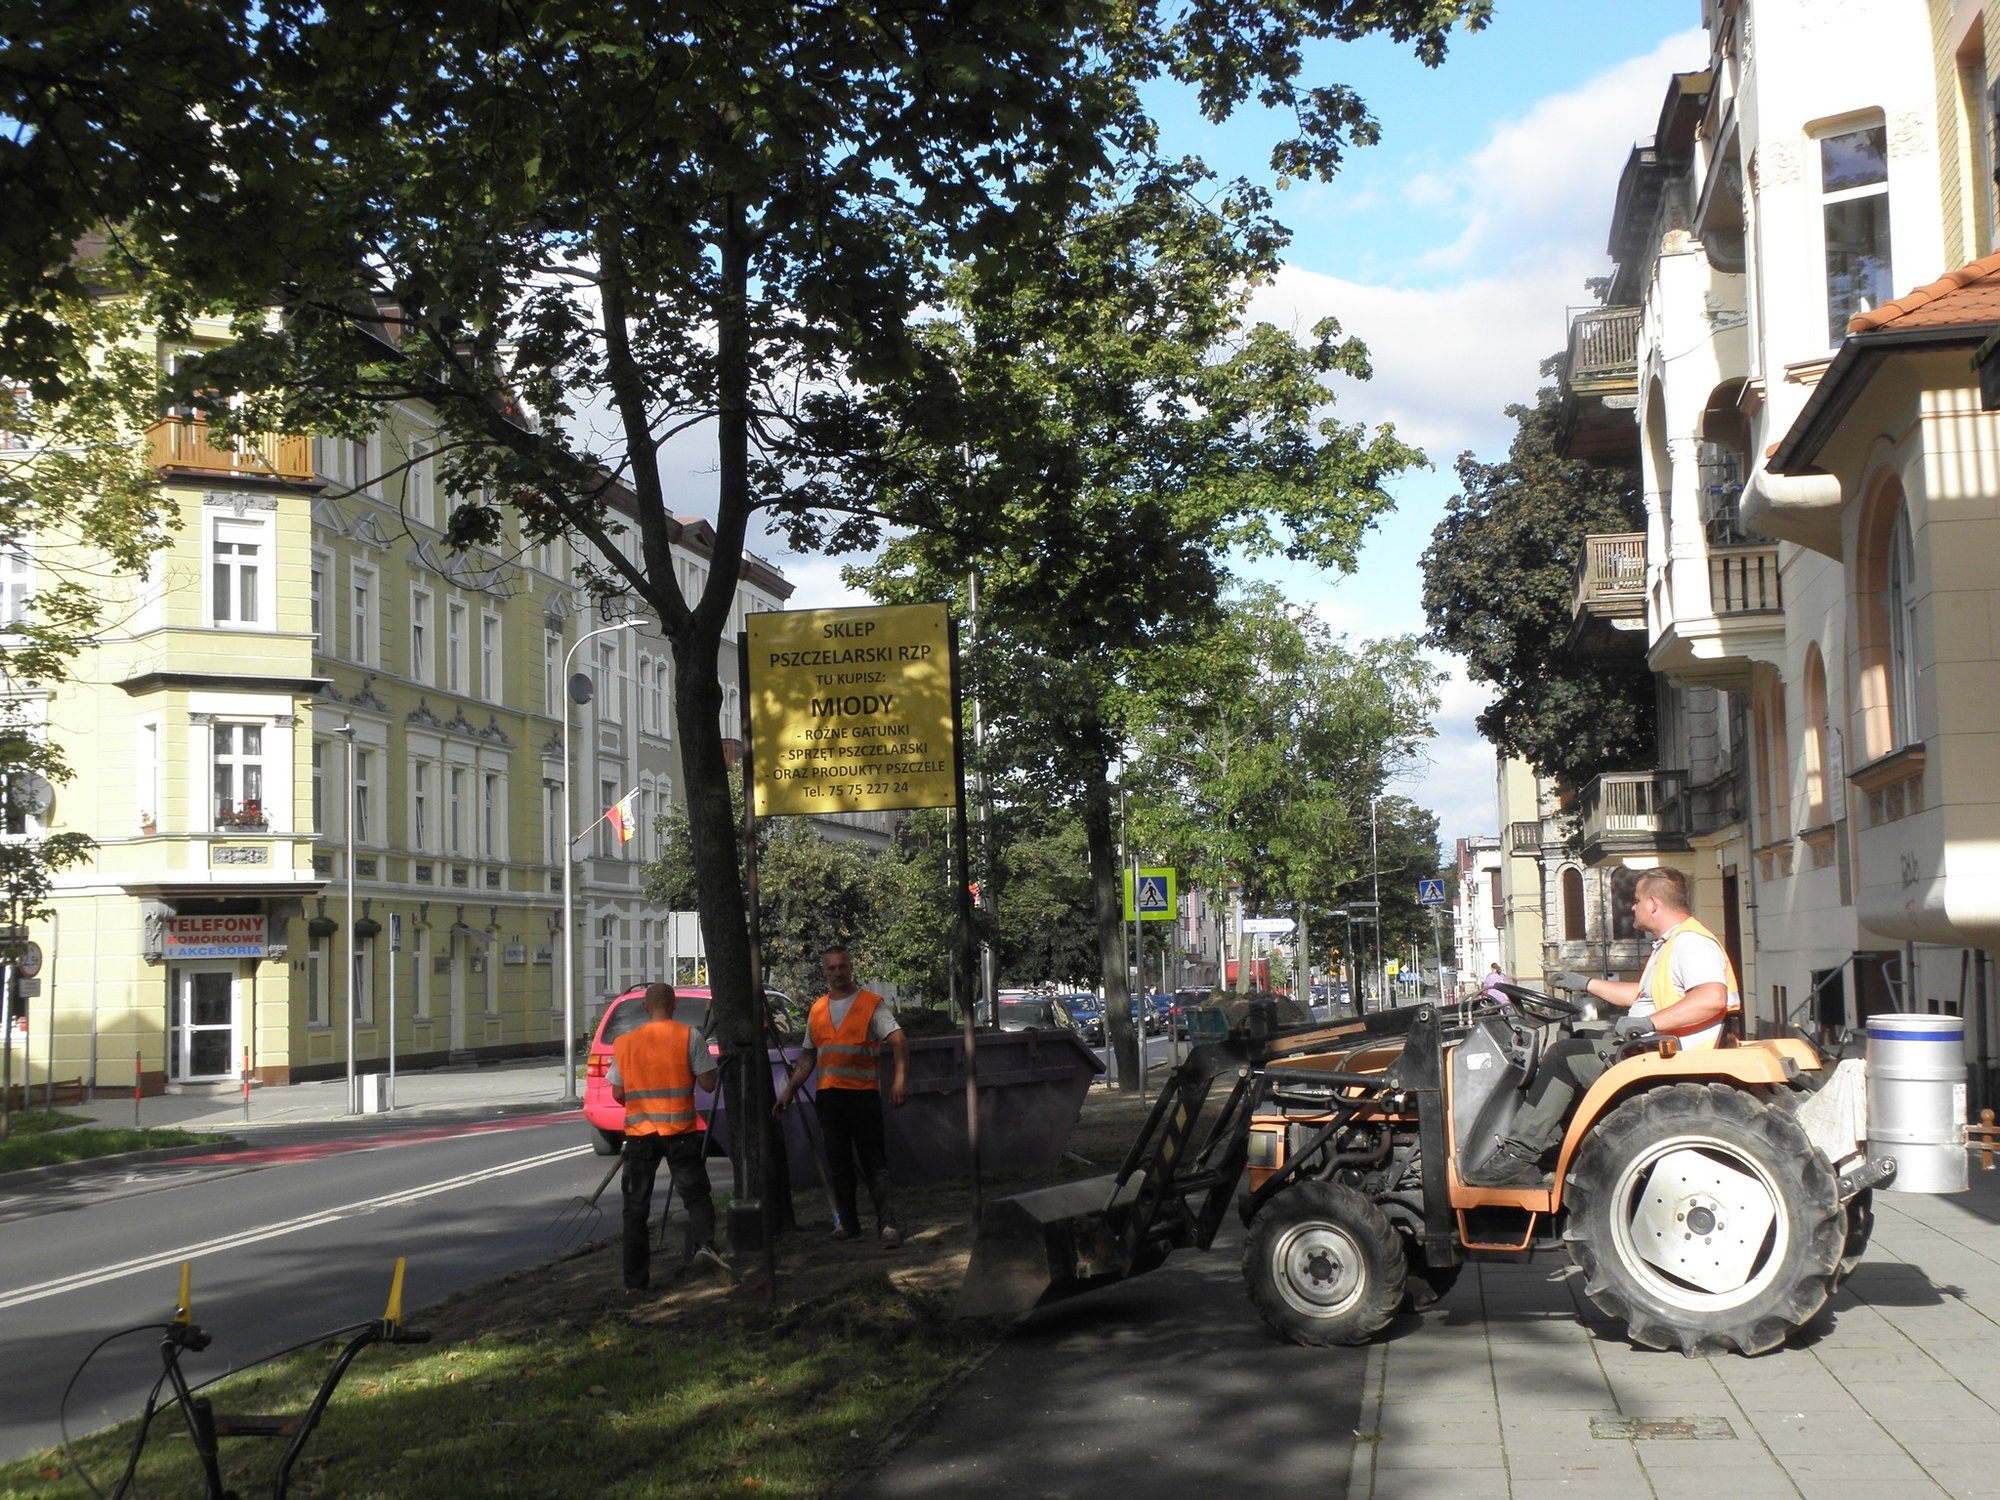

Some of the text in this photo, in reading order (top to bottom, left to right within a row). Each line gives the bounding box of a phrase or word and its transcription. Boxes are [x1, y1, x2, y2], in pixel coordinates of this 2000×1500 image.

[823, 622, 875, 639] SKLEP
[770, 645, 931, 668] PSZCZELARSKI RZP
[816, 671, 886, 686] TU KUPISZ:
[811, 694, 893, 718] MIODY
[805, 726, 848, 741] RÓŻNE
[852, 724, 910, 738] GATUNKI
[788, 747, 834, 762] SPRZĘT
[839, 742, 928, 759] PSZCZELARSKI
[773, 768, 808, 780] ORAZ
[812, 763, 882, 779] PRODUKTY
[886, 760, 945, 775] PSZCZELE
[803, 781, 909, 798] Tel. 75 75 227 24
[166, 917, 265, 933] TELEFONY
[167, 933, 263, 944] KOMÓRKOWE
[168, 946, 261, 956] I AKCESORIA
